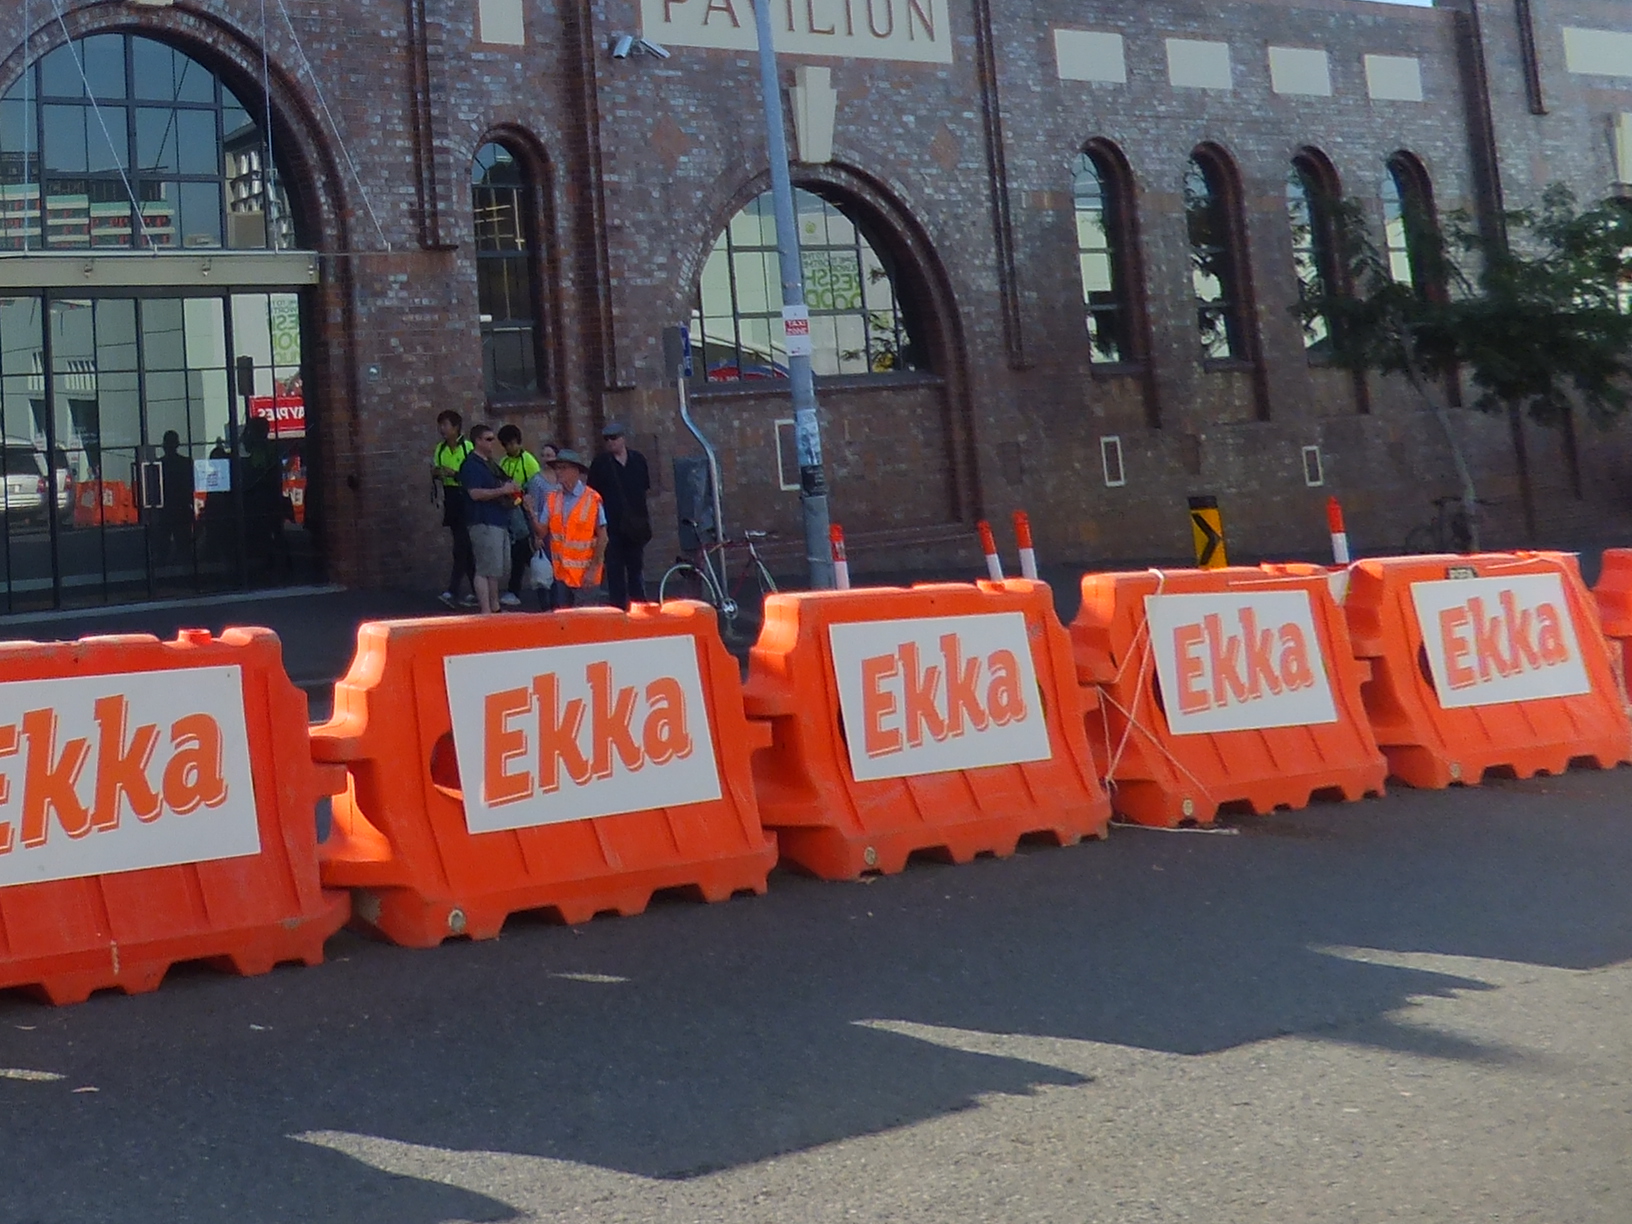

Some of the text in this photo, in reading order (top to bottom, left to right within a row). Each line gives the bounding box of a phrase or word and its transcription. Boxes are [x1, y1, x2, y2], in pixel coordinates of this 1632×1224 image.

[860, 632, 1028, 759] Ekka
[1173, 606, 1316, 715] Ekka
[1438, 589, 1569, 691] Ekka
[481, 659, 693, 808] Ekka
